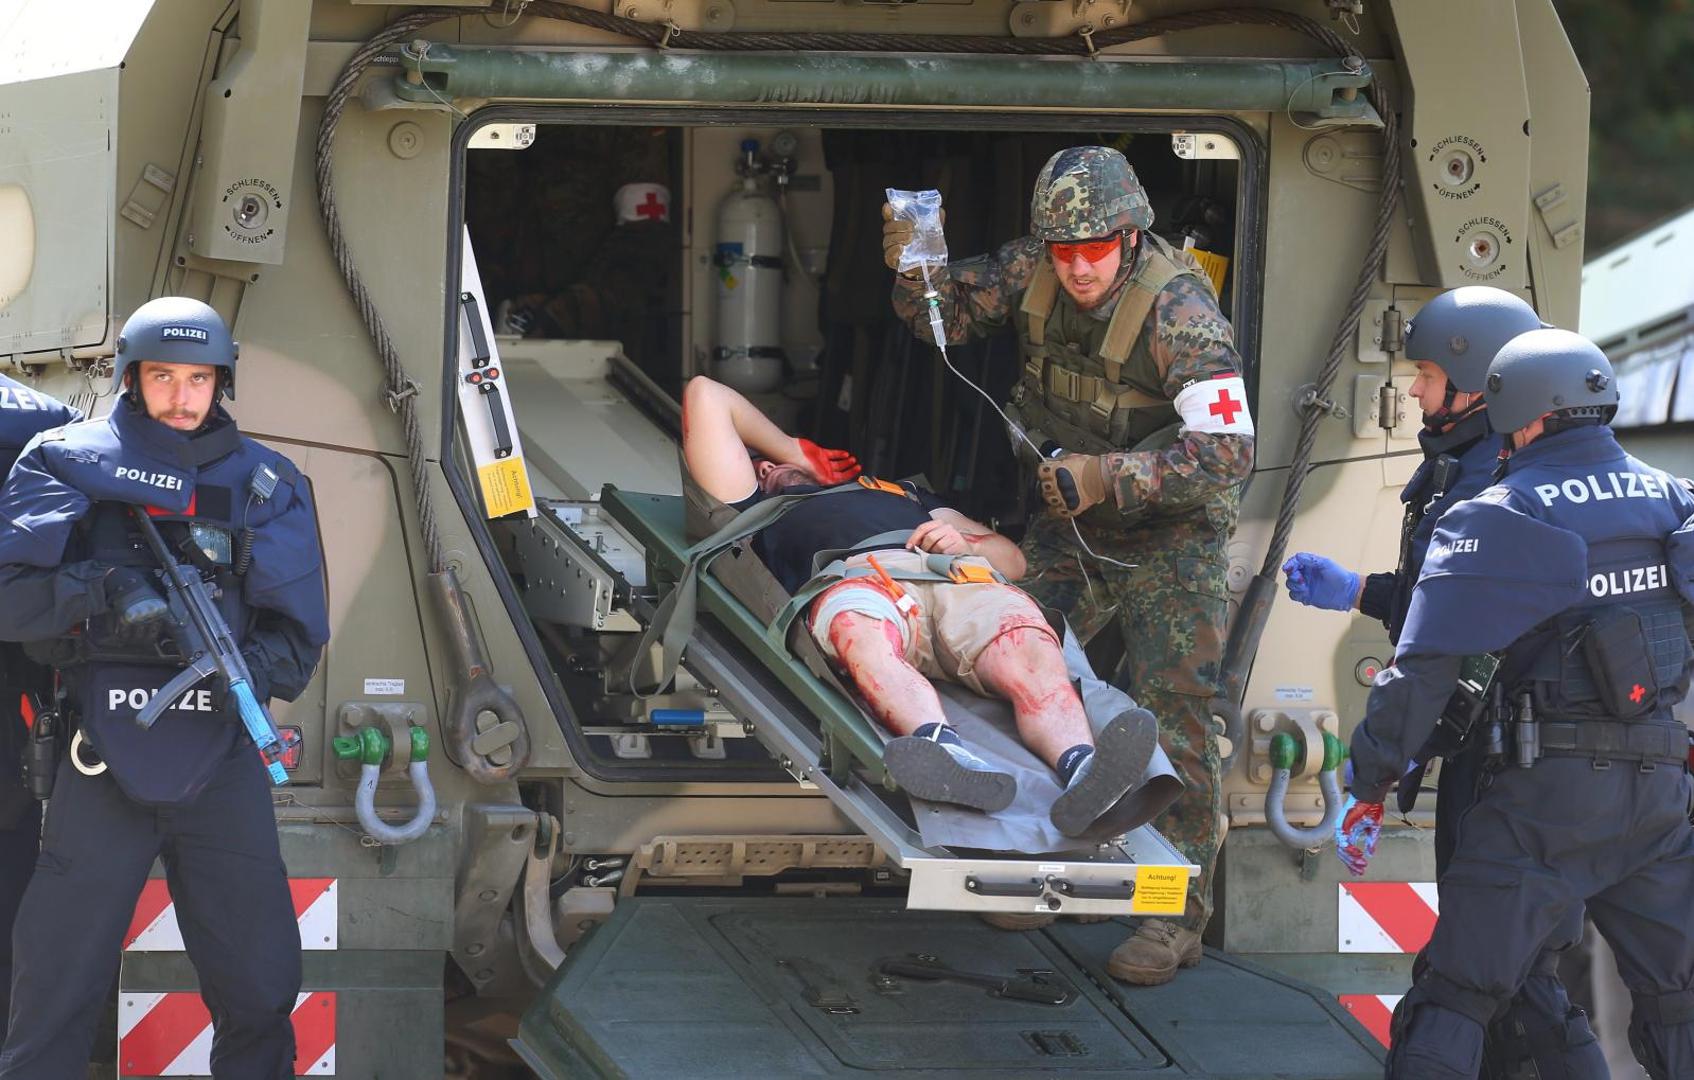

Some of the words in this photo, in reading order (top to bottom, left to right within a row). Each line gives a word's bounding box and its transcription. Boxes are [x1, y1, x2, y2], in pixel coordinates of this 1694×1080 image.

[1433, 136, 1484, 155] SCHLIESSEN
[227, 179, 279, 200] SCHLIESSEN
[1458, 216, 1509, 236] SCHLIESSEN
[163, 328, 207, 340] POLIZEI
[115, 466, 183, 491] POLIZEI
[1586, 564, 1668, 598] OLIZEI
[109, 688, 219, 712] POZE
[1147, 873, 1177, 883] Achtung!
